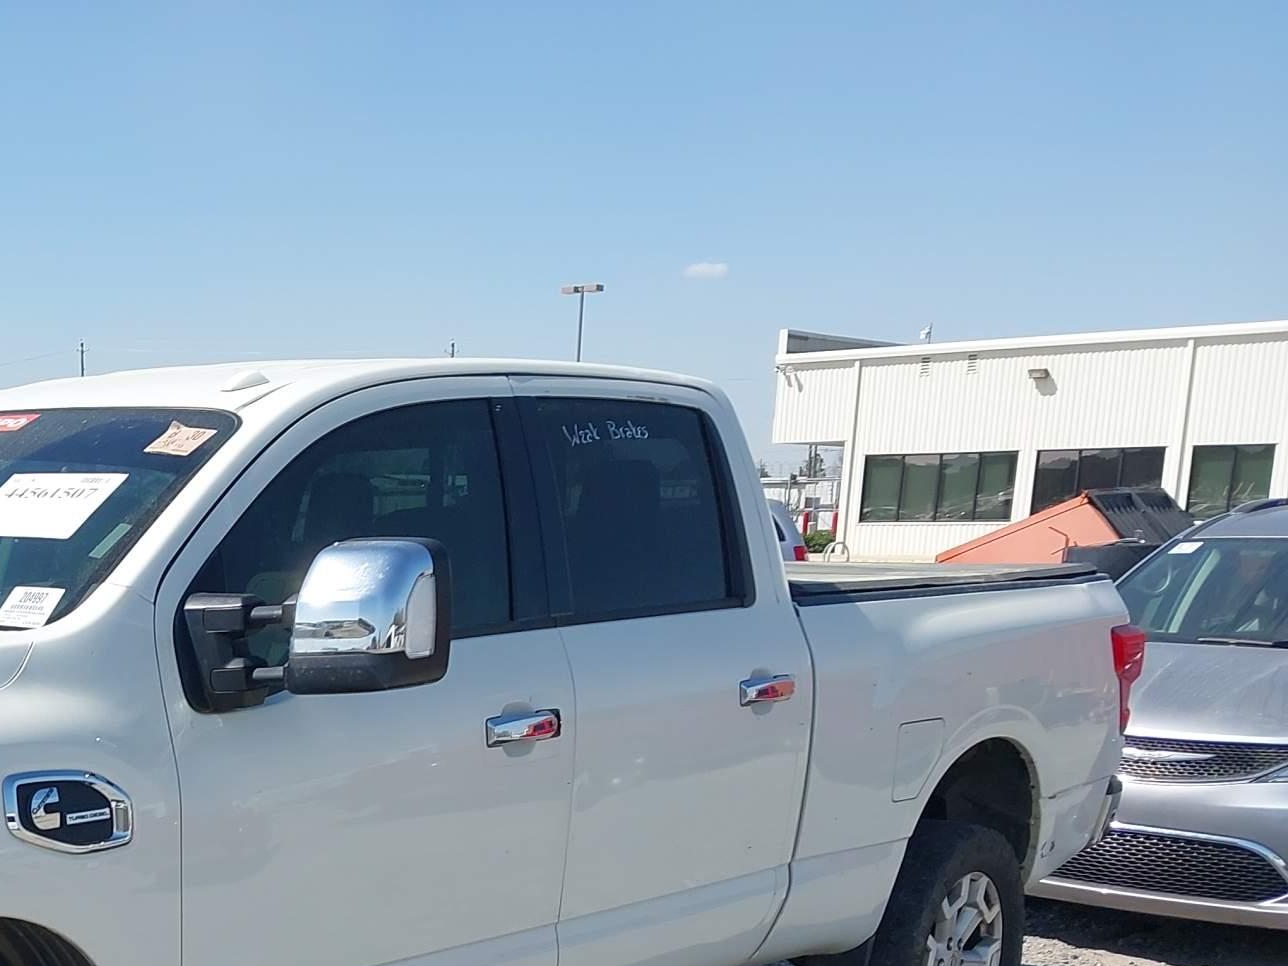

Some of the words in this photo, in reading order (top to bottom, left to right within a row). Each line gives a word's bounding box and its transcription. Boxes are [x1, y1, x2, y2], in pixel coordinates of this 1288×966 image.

[562, 422, 600, 447] Weak
[606, 419, 649, 440] Brakes
[4, 487, 99, 500] 44561507
